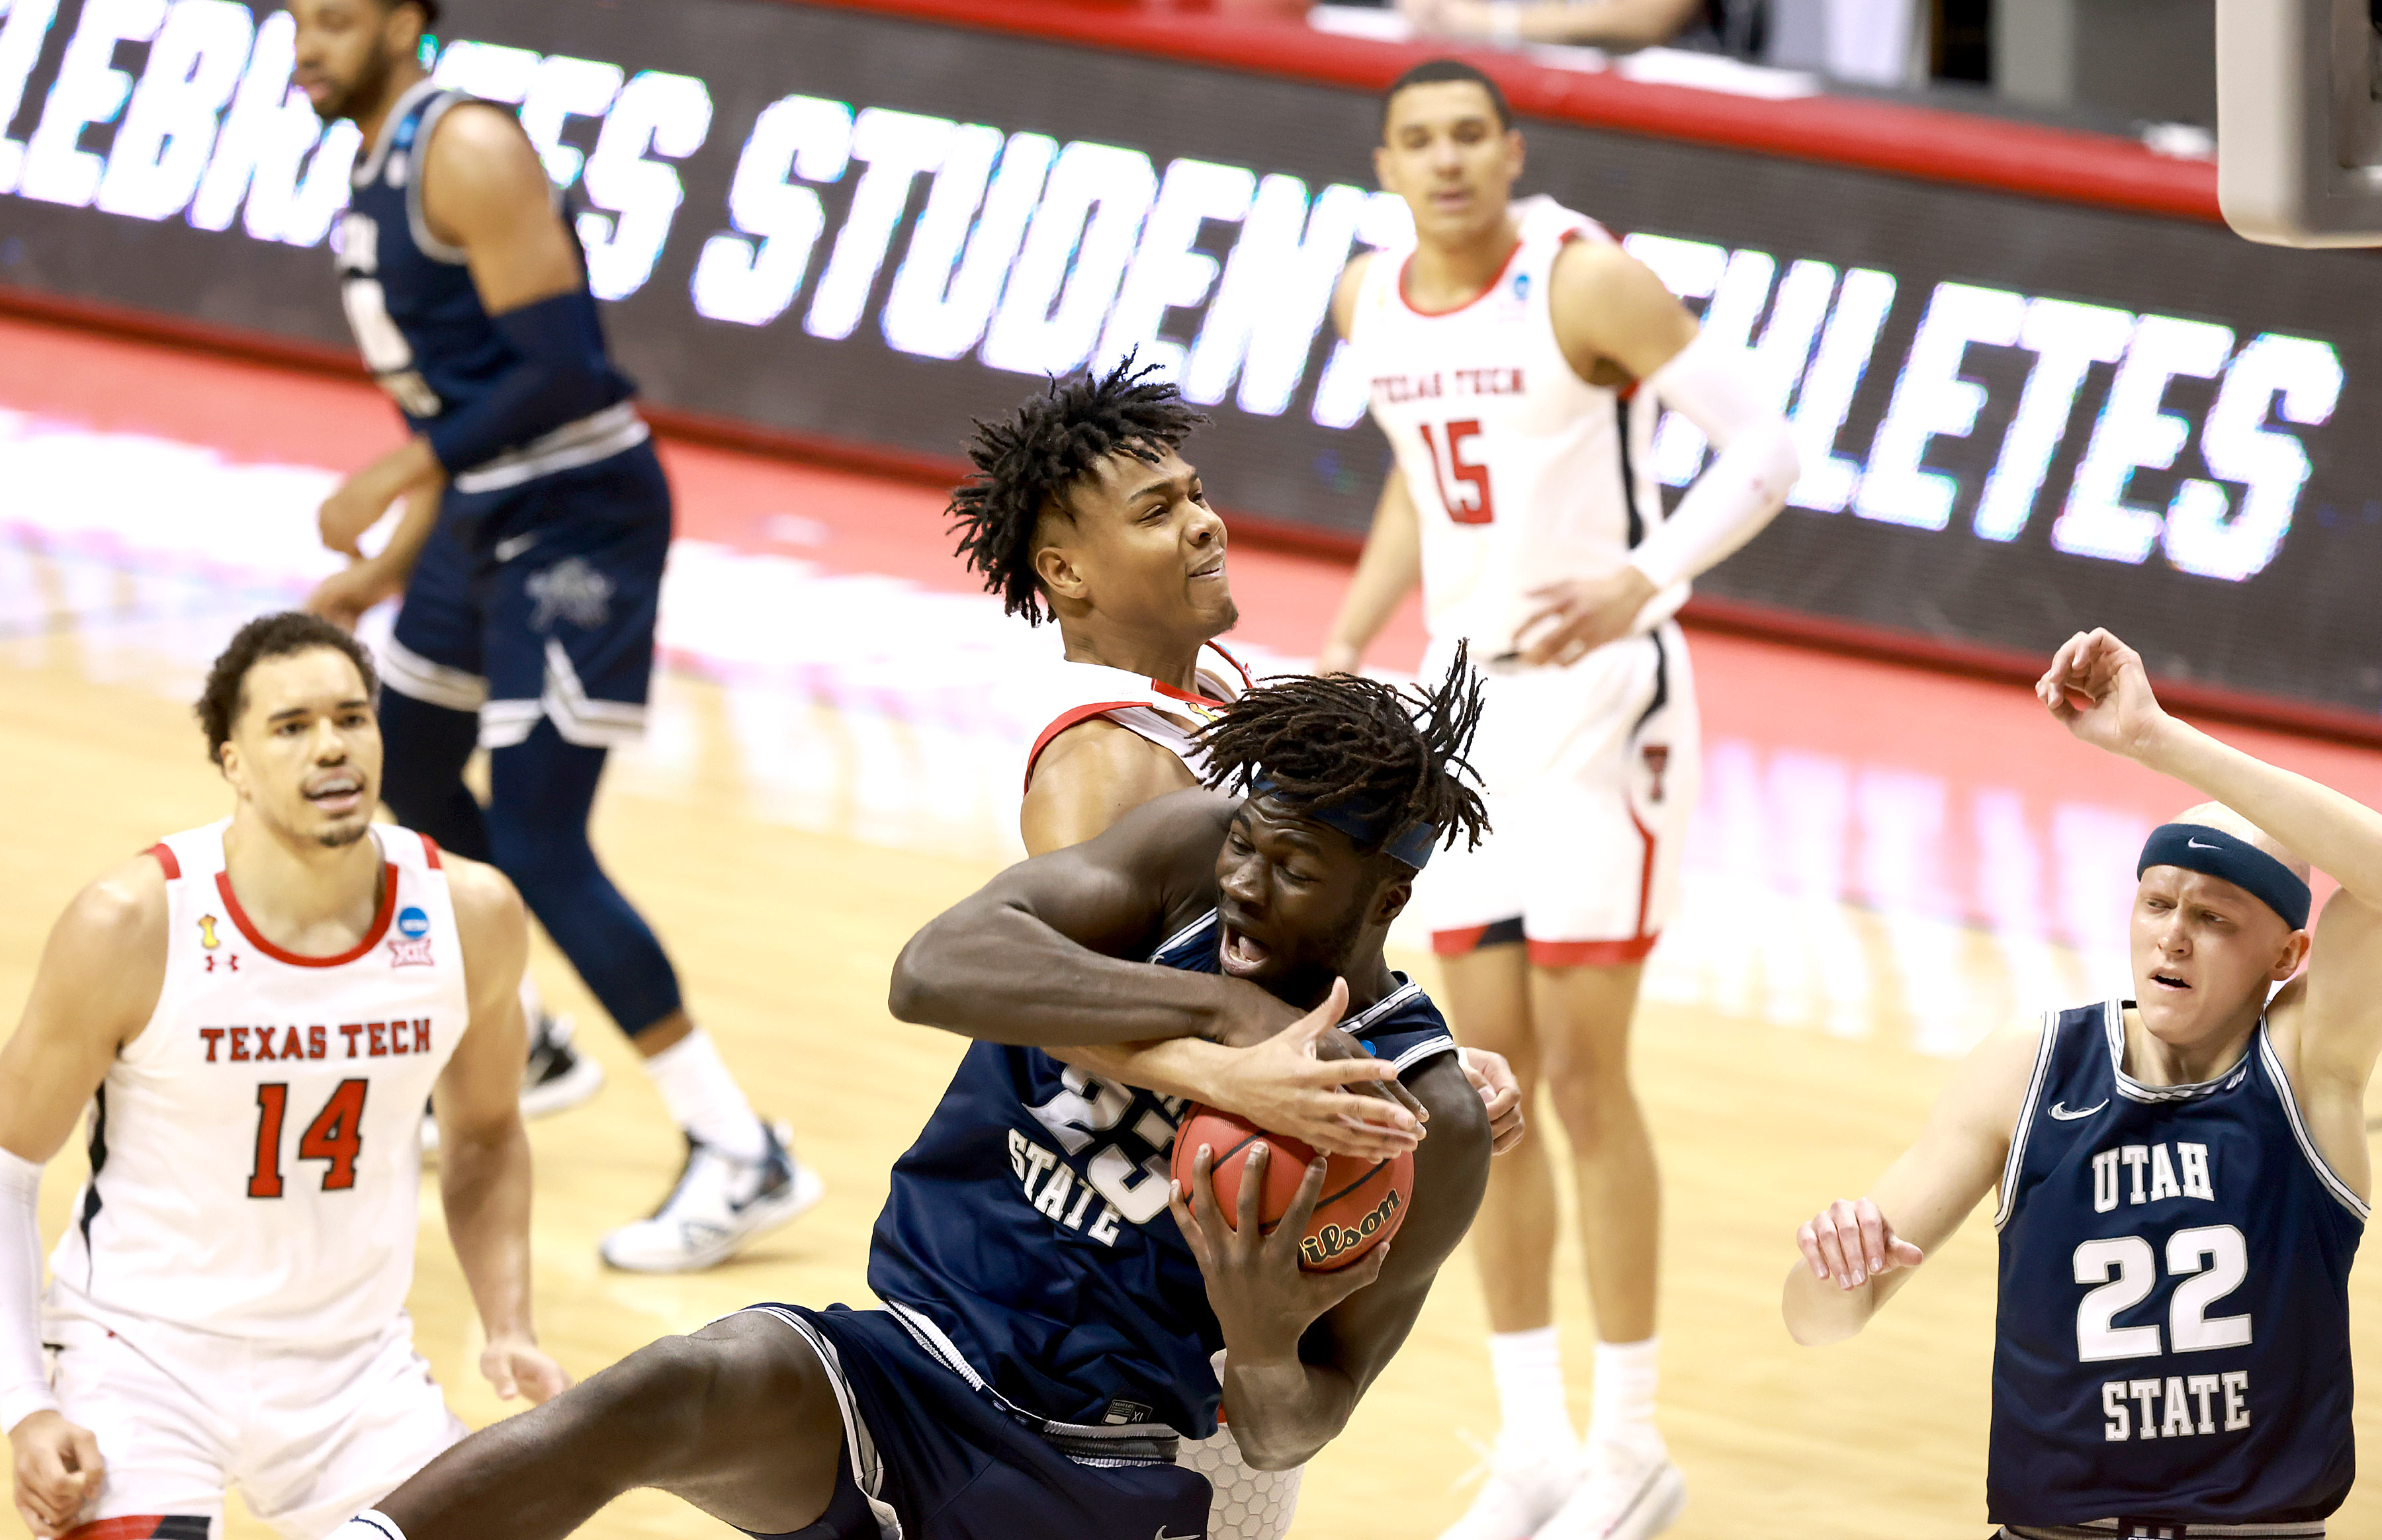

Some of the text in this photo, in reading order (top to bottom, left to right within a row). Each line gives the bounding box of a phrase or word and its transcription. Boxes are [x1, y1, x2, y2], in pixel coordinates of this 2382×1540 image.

[1622, 232, 2346, 582] HLETES
[1419, 419, 1494, 524] 15
[200, 1019, 431, 1062] TEXAS TECH
[247, 1078, 369, 1199] 14
[1008, 1127, 1121, 1248] STATE
[2092, 1141, 2214, 1214] UTAH
[1296, 1188, 1401, 1265] ilson
[2072, 1224, 2253, 1363] 22
[2102, 1370, 2251, 1442] STATE
